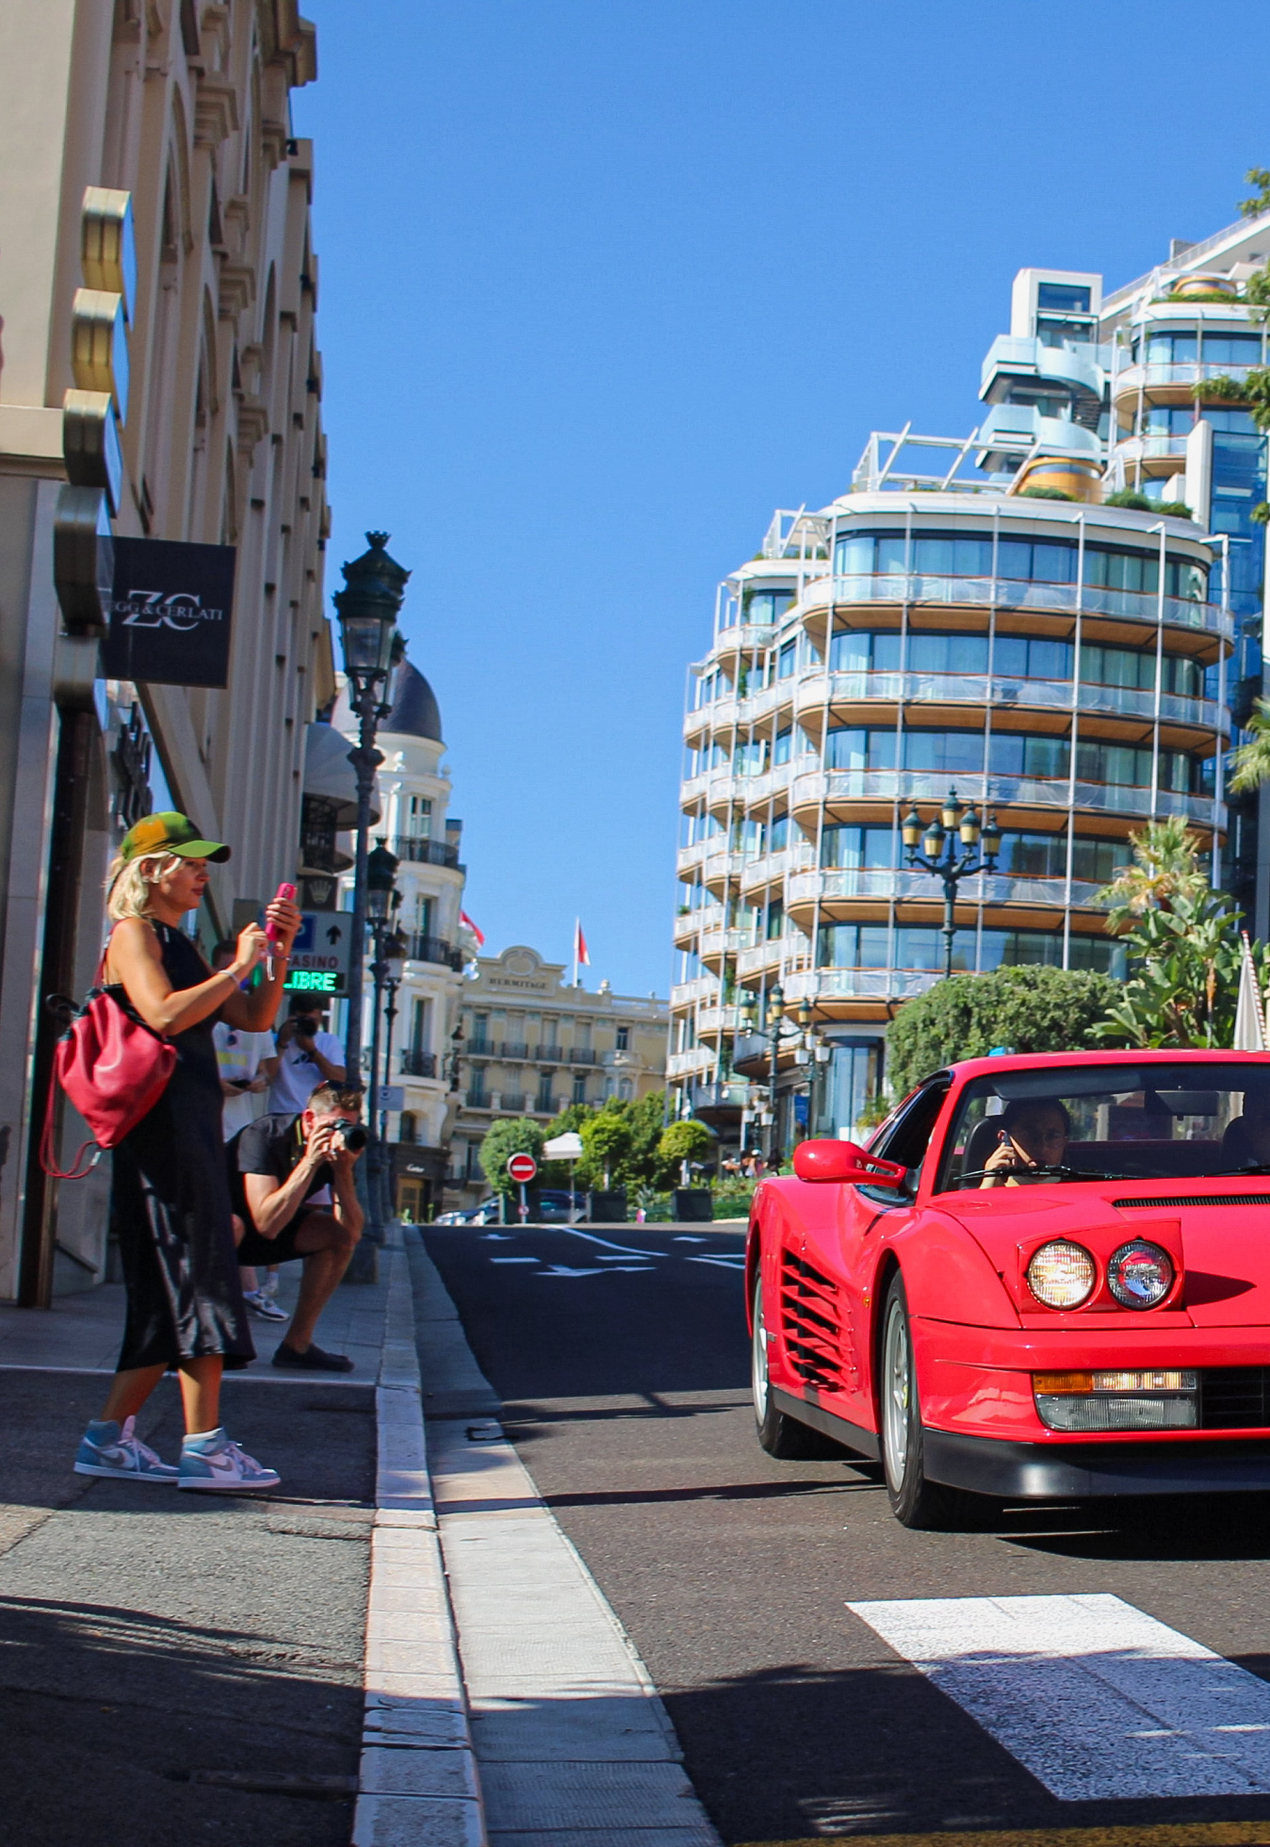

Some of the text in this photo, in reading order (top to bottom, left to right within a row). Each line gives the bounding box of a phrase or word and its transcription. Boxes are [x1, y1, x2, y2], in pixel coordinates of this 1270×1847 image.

[122, 590, 201, 631] ZC
[142, 603, 153, 615] &
[156, 605, 224, 621] CERLATI
[289, 954, 338, 969] ASINO
